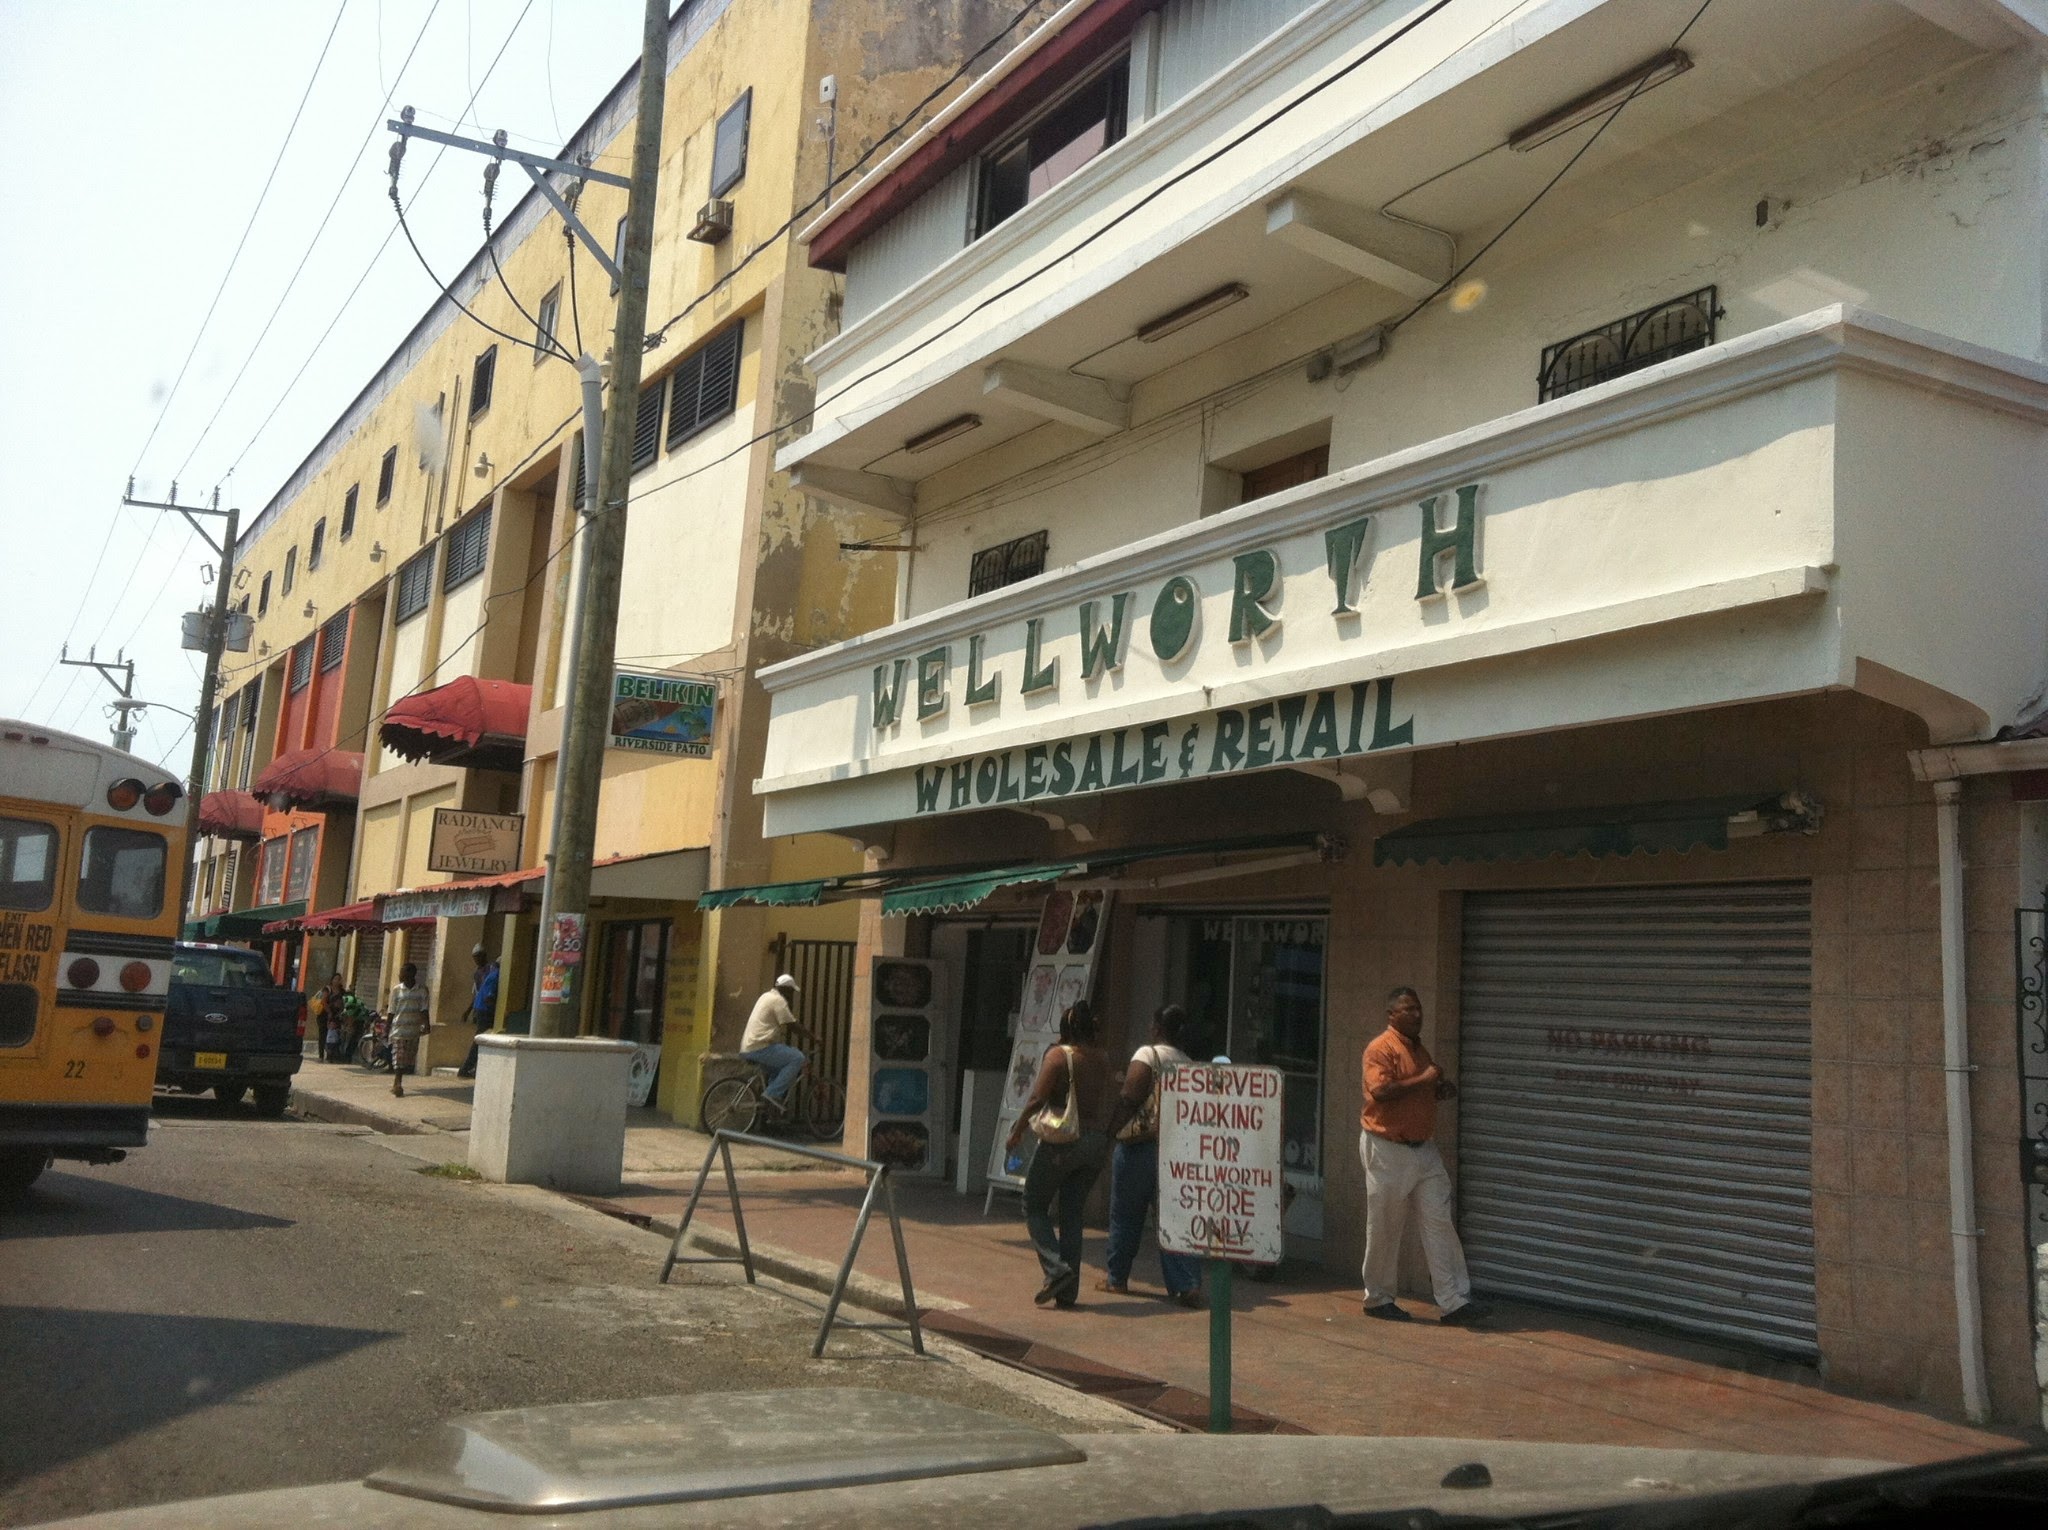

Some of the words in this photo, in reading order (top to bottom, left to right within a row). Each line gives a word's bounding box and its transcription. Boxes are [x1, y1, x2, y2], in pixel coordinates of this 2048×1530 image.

[873, 484, 1482, 728] WELLWORTH
[616, 677, 714, 707] BELIKIN
[614, 736, 673, 752] RIVERSIDE
[675, 743, 707, 755] PATIO
[914, 722, 1171, 814] WHOLESALE
[1178, 722, 1200, 777] &
[1207, 677, 1414, 773] RETAIL
[438, 812, 519, 832] RADIANCE
[437, 855, 511, 873] JEWELRY
[25, 924, 53, 952] RED
[1548, 1026, 1581, 1053] NO
[1590, 1026, 1713, 1061] PARKING
[64, 1061, 86, 1079] 22
[1163, 1068, 1278, 1098] RESERVED
[1176, 1099, 1263, 1132] PARKING
[1199, 1134, 1240, 1163] FOR
[1169, 1161, 1272, 1188] WELLWORTH
[1179, 1184, 1255, 1218] STORE
[1191, 1214, 1249, 1247] ONLY
